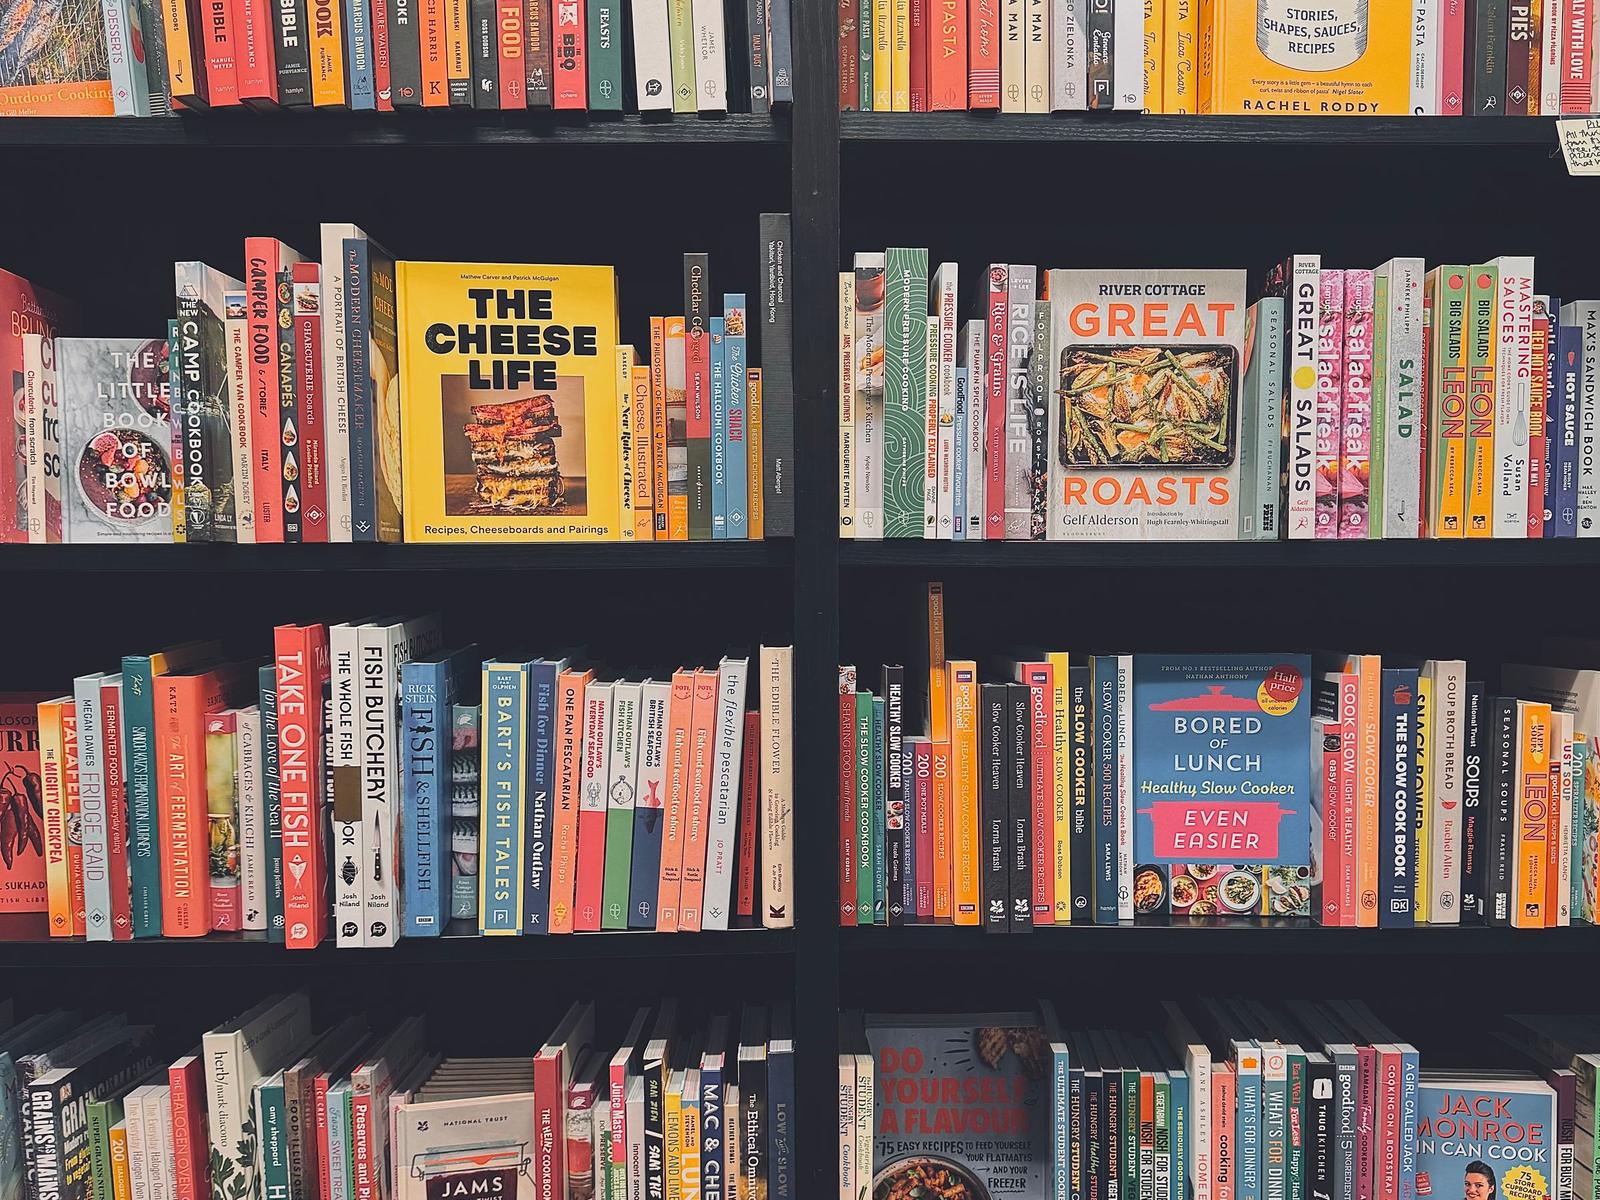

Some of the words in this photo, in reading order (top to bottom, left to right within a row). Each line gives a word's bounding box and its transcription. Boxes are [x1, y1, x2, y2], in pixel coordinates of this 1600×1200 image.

[212, 5, 226, 43] BIBLE
[600, 8, 609, 49] FEASTS
[942, 2, 957, 59] PASTA
[1009, 14, 1018, 42] MAN
[1263, 20, 1311, 39] SHAPES,
[1314, 21, 1361, 38] SAUCES,
[1287, 8, 1338, 22] STORIES,
[1416, 9, 1424, 47] PASTA
[1511, 5, 1528, 41] PIES
[106, 9, 123, 64] DESSERTS
[429, 21, 437, 63] HARRIS
[500, 7, 518, 59] FOOD
[1066, 15, 1074, 69] ZIELONKA
[1288, 42, 1335, 54] RECIPES
[1569, 19, 1583, 48] WITH
[562, 34, 576, 72] BBQ
[1569, 50, 1583, 80] LOVE
[1243, 100, 1311, 111] RACHEL
[1321, 101, 1378, 112] RODDY
[468, 288, 552, 319] THE
[1099, 285, 1141, 296] RIVER
[1144, 285, 1205, 296] COTTAGE
[1069, 302, 1235, 337] GREAT
[1298, 284, 1314, 360] GREAT
[1450, 301, 1462, 316] BIG
[1503, 277, 1515, 343] SAUCES
[425, 323, 597, 356] CHEESE
[1449, 319, 1461, 359] SALADS
[1518, 277, 1532, 378] MASTERING
[1587, 310, 1596, 350] MAX'S
[111, 352, 154, 368] THE
[183, 321, 200, 381] CAMP
[303, 321, 313, 391] CHARCUTERIE
[27, 370, 35, 414] Charcuterie
[97, 382, 169, 398] LITTLE
[280, 342, 296, 408] CANAPÉS
[469, 360, 557, 390] LIFE
[1566, 373, 1575, 403] HOT
[636, 384, 647, 433] Cheese,
[1398, 359, 1414, 439] SALAD
[1442, 366, 1465, 439] LEON
[1585, 357, 1595, 430] SANDWICH
[103, 413, 168, 428] BOOK
[187, 389, 202, 486] COOKBOOK
[238, 400, 246, 449] COOKBOOK
[1564, 407, 1575, 446] SAUCE
[121, 443, 152, 458] OF
[1295, 400, 1313, 492] SALADS
[1583, 437, 1593, 475] BOOK
[105, 473, 171, 488] BOWL
[637, 436, 650, 498] Illustrated
[1503, 454, 1512, 496] Volland
[1515, 459, 1524, 491] Susan
[1063, 476, 1230, 506] ROASTS
[106, 503, 171, 518] FOOD
[1062, 515, 1086, 526] Gelf
[1088, 515, 1139, 526] Alderson
[1147, 519, 1162, 527] Hugh
[424, 525, 468, 535] Recipes,
[470, 525, 544, 534] Cheeseboards
[547, 526, 565, 534] and
[569, 526, 608, 535] Pairings
[278, 651, 303, 716] TAKE
[363, 647, 382, 689] FISH
[727, 675, 738, 694] the
[1273, 671, 1297, 682] Half
[406, 695, 437, 703] STEIN
[408, 684, 434, 694] RICK
[890, 684, 900, 723] HEALTHY
[1074, 687, 1083, 702] the
[1270, 682, 1296, 692] price
[83, 700, 92, 730] MEGAN
[722, 698, 737, 748] flexible
[1075, 705, 1084, 743] SLOW
[1174, 717, 1262, 734] BORED
[1397, 713, 1408, 738] THE
[86, 733, 94, 766] DAVIES
[365, 694, 386, 803] BUTCHERY
[497, 697, 512, 772] BART'S
[890, 726, 900, 749] SLOW
[1210, 739, 1228, 749] OF
[281, 724, 306, 783] ONE
[890, 751, 900, 789] COOKER
[918, 753, 929, 777] 200
[1174, 754, 1262, 772] LUNCH
[1396, 739, 1407, 788] SLOW
[717, 753, 731, 825] pescatarian
[1075, 747, 1085, 805] COOKER
[1141, 781, 1197, 797] Healthy
[1201, 781, 1237, 794] Slow
[1240, 782, 1295, 794] Cooker
[1465, 755, 1480, 807] SOUPS
[82, 773, 102, 835] FRIDGE
[284, 793, 309, 847] FISH
[496, 781, 510, 828] FISH
[532, 791, 546, 839] Nathan
[1075, 809, 1083, 834] bible
[1184, 810, 1249, 827] EVEN
[1395, 790, 1407, 836] COOK
[1523, 773, 1547, 841] LEON
[1174, 833, 1260, 849] EASIER
[1394, 839, 1406, 877] BOOK
[85, 842, 104, 881] RAID
[495, 838, 510, 900] TALES
[532, 842, 544, 890] Outlaw
[880, 1047, 923, 1073] DO
[611, 1082, 623, 1111] Juice
[704, 1085, 720, 1130] MAC
[880, 1078, 1026, 1104] YOURSELF
[1244, 1086, 1255, 1123] WHAT'S
[1439, 1094, 1512, 1119] JACK
[217, 1110, 228, 1147] diacono
[611, 1113, 623, 1144] Master
[879, 1108, 898, 1134] A
[905, 1108, 1030, 1134] FLAVOUR
[1244, 1125, 1255, 1146] FOR
[878, 1142, 894, 1156] 75
[897, 1142, 920, 1152] EASY
[923, 1142, 964, 1154] RECIPES
[1441, 1142, 1482, 1158] CAN
[1488, 1146, 1547, 1163] COOK
[988, 1178, 1026, 1189] FREEZER
[1244, 1147, 1256, 1189] DINNER?
[1514, 1179, 1535, 1188] STORE
[1520, 1171, 1531, 1180] 75
[442, 1176, 503, 1197] JAMS
[1505, 1184, 1542, 1196] CUPBOARD
